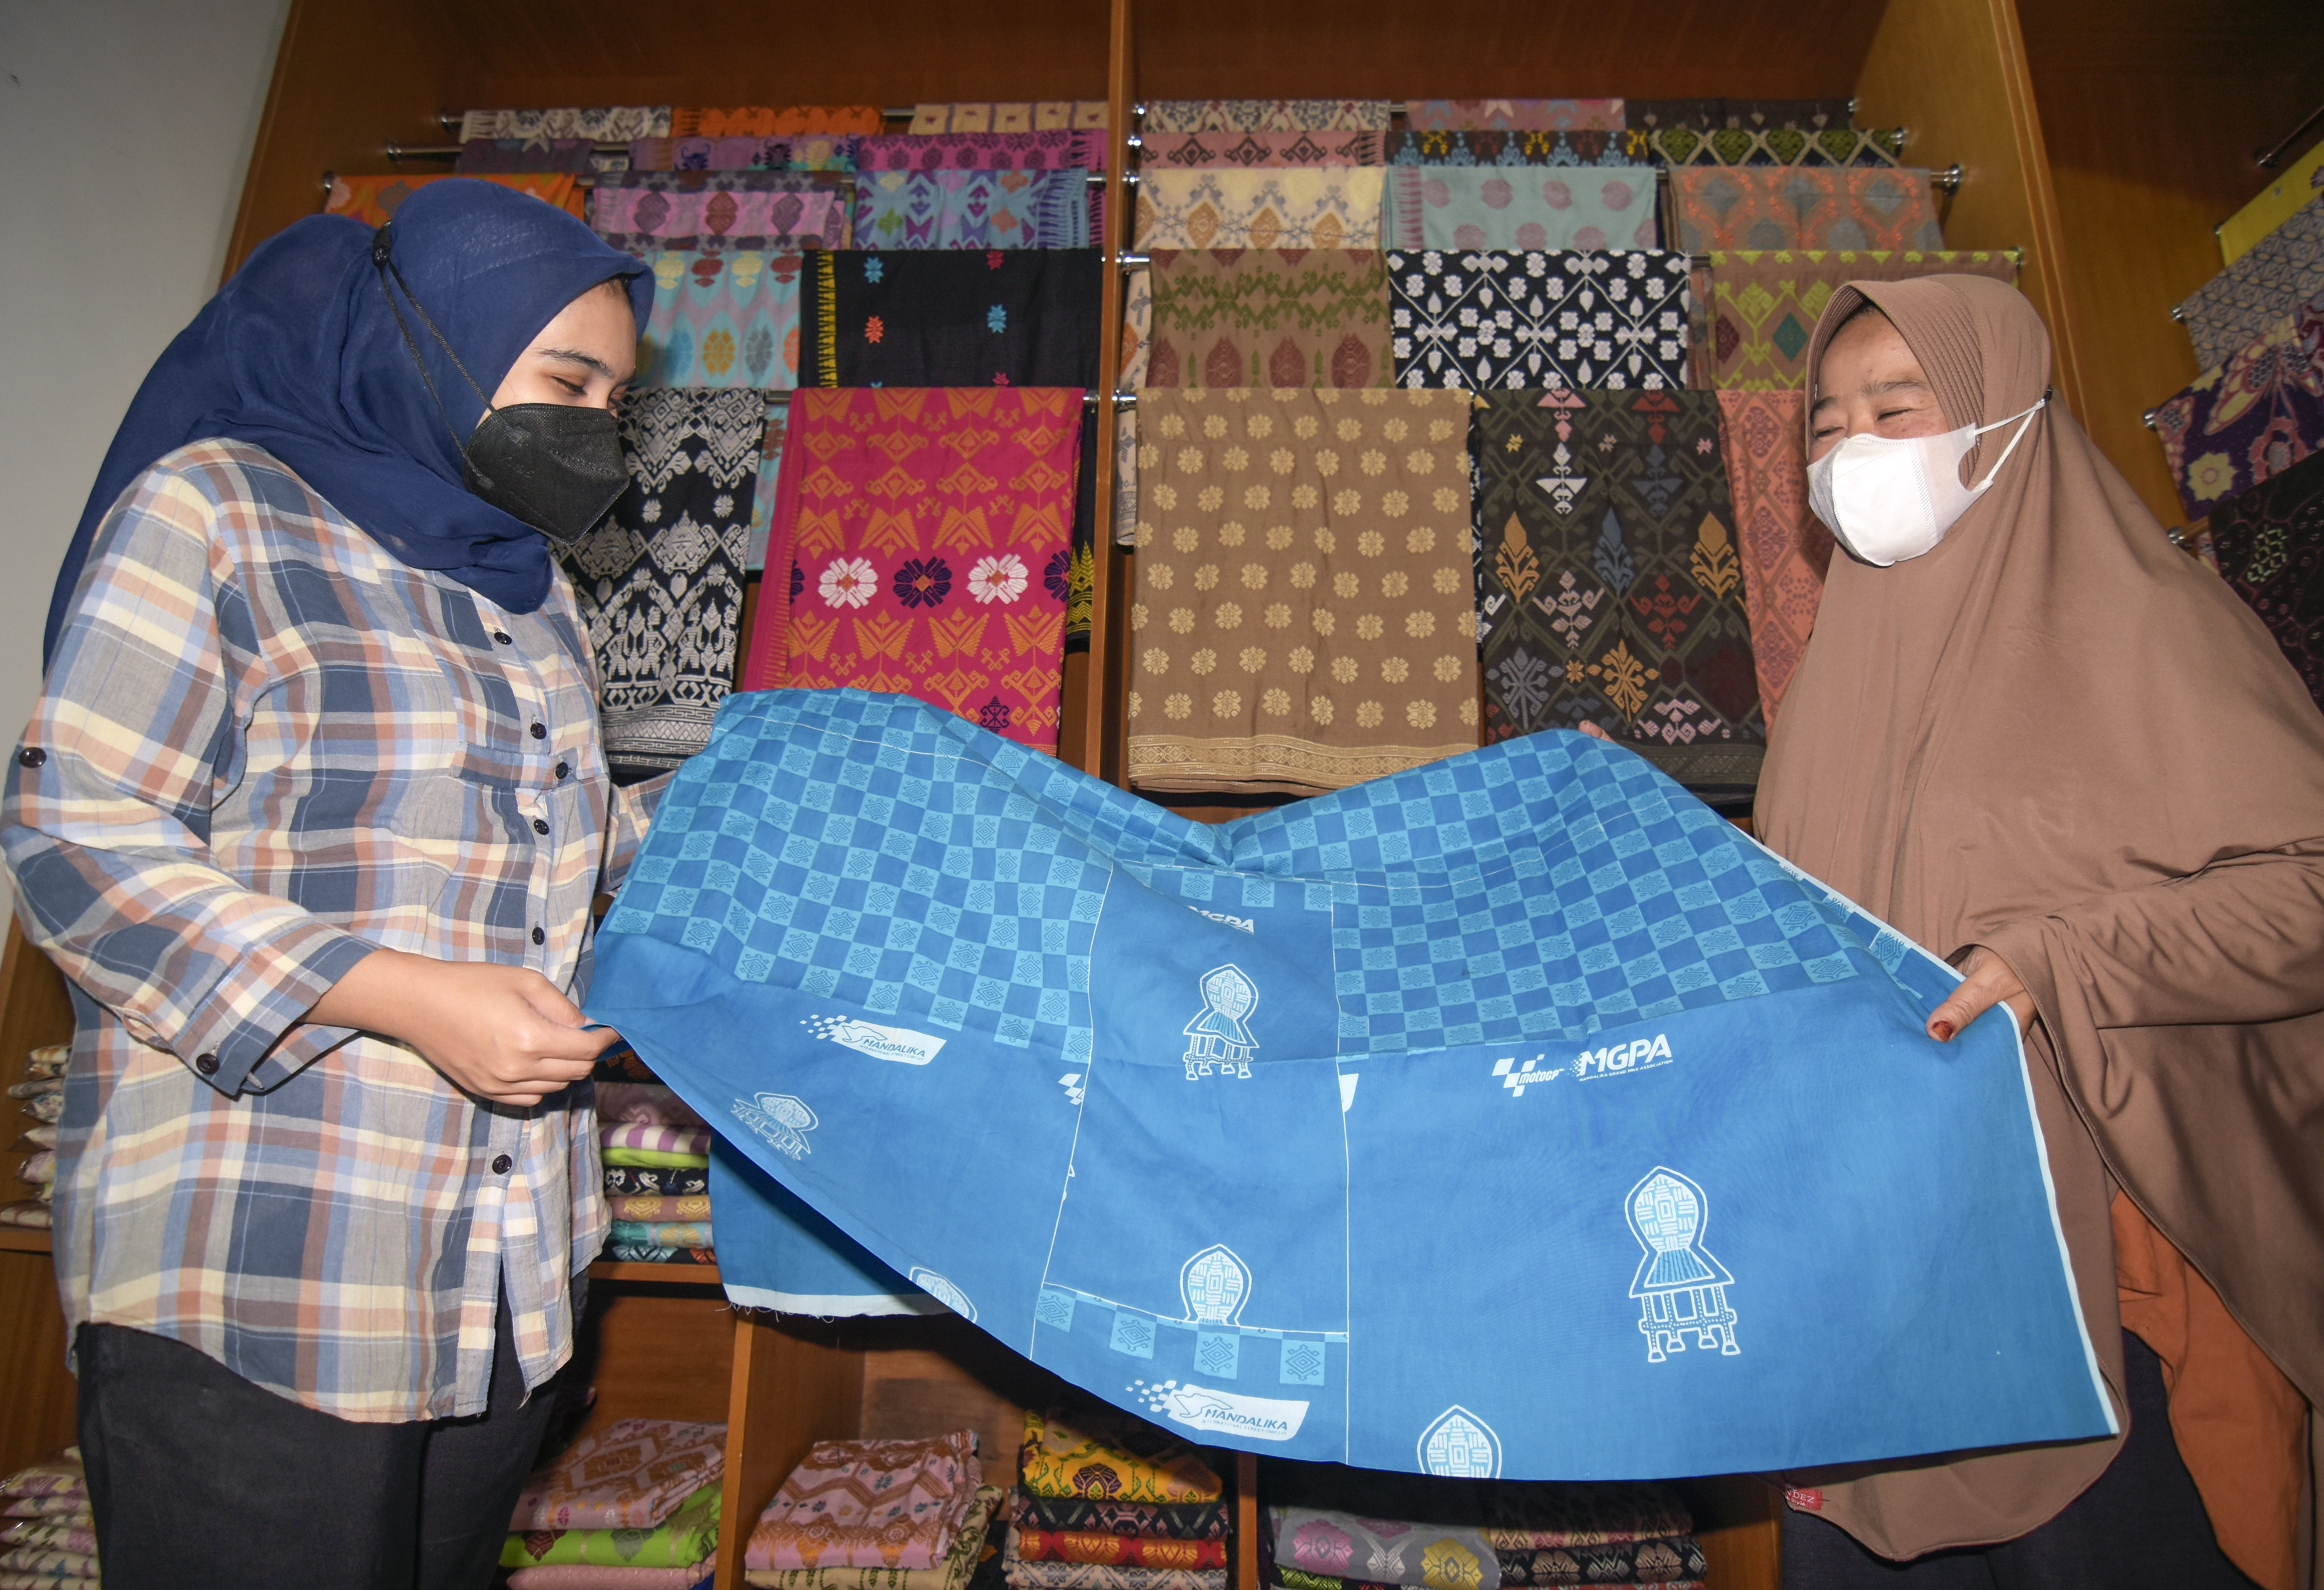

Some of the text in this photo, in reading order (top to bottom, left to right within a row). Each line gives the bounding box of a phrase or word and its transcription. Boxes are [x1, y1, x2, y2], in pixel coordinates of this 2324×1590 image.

[859, 1044, 890, 1056] INTERNATIONAL
[863, 1039, 925, 1057] MANDALIKA
[1577, 1034, 1672, 1076] MGPA
[1640, 1059, 1674, 1070] ASSOCIATION
[1204, 1409, 1288, 1430] MANDALIKA
